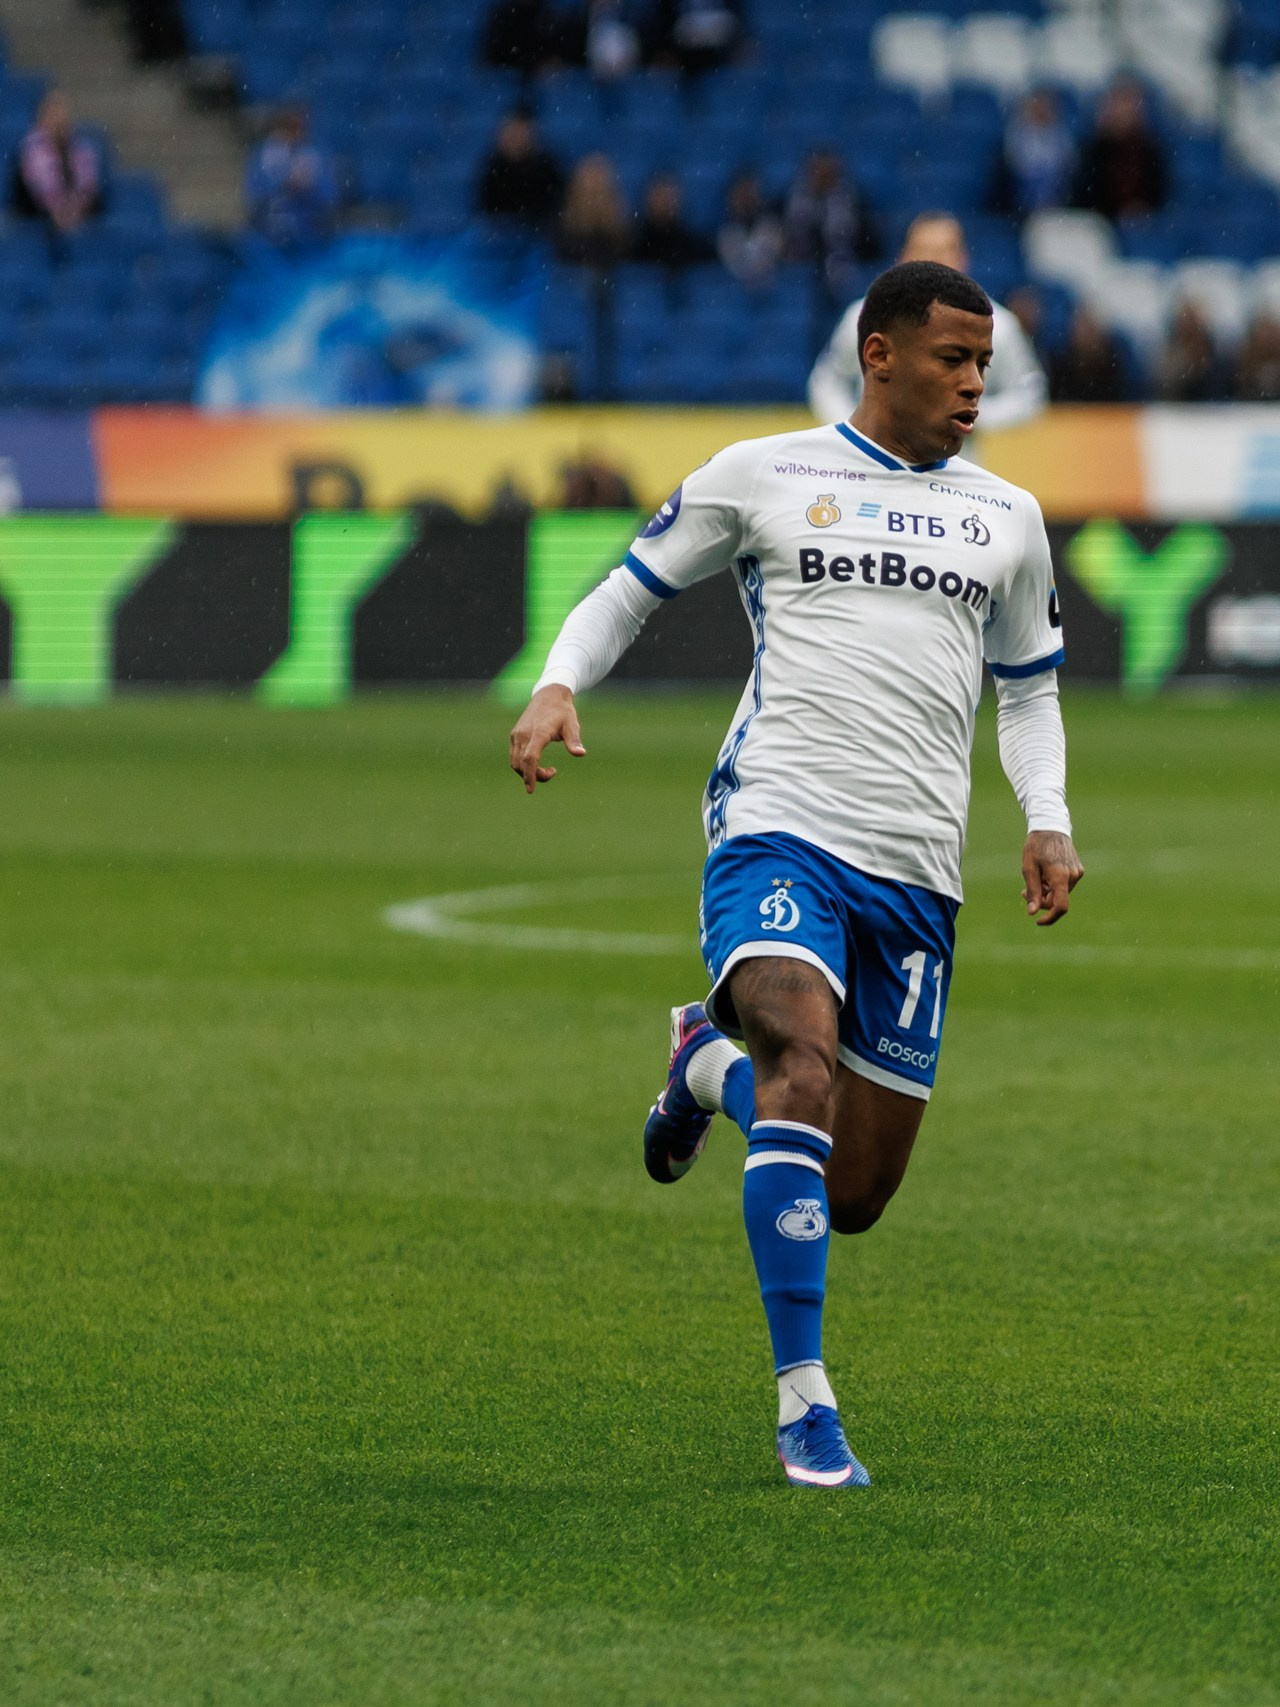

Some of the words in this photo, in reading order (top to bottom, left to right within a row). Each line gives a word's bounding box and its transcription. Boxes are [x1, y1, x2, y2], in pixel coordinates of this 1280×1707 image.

[774, 462, 867, 481] wildberries
[929, 482, 1012, 511] CHANGAN
[887, 511, 946, 538] ВТБ
[799, 547, 990, 611] BetBoom
[897, 950, 944, 1039] 11
[876, 1036, 930, 1069] BOSCO
